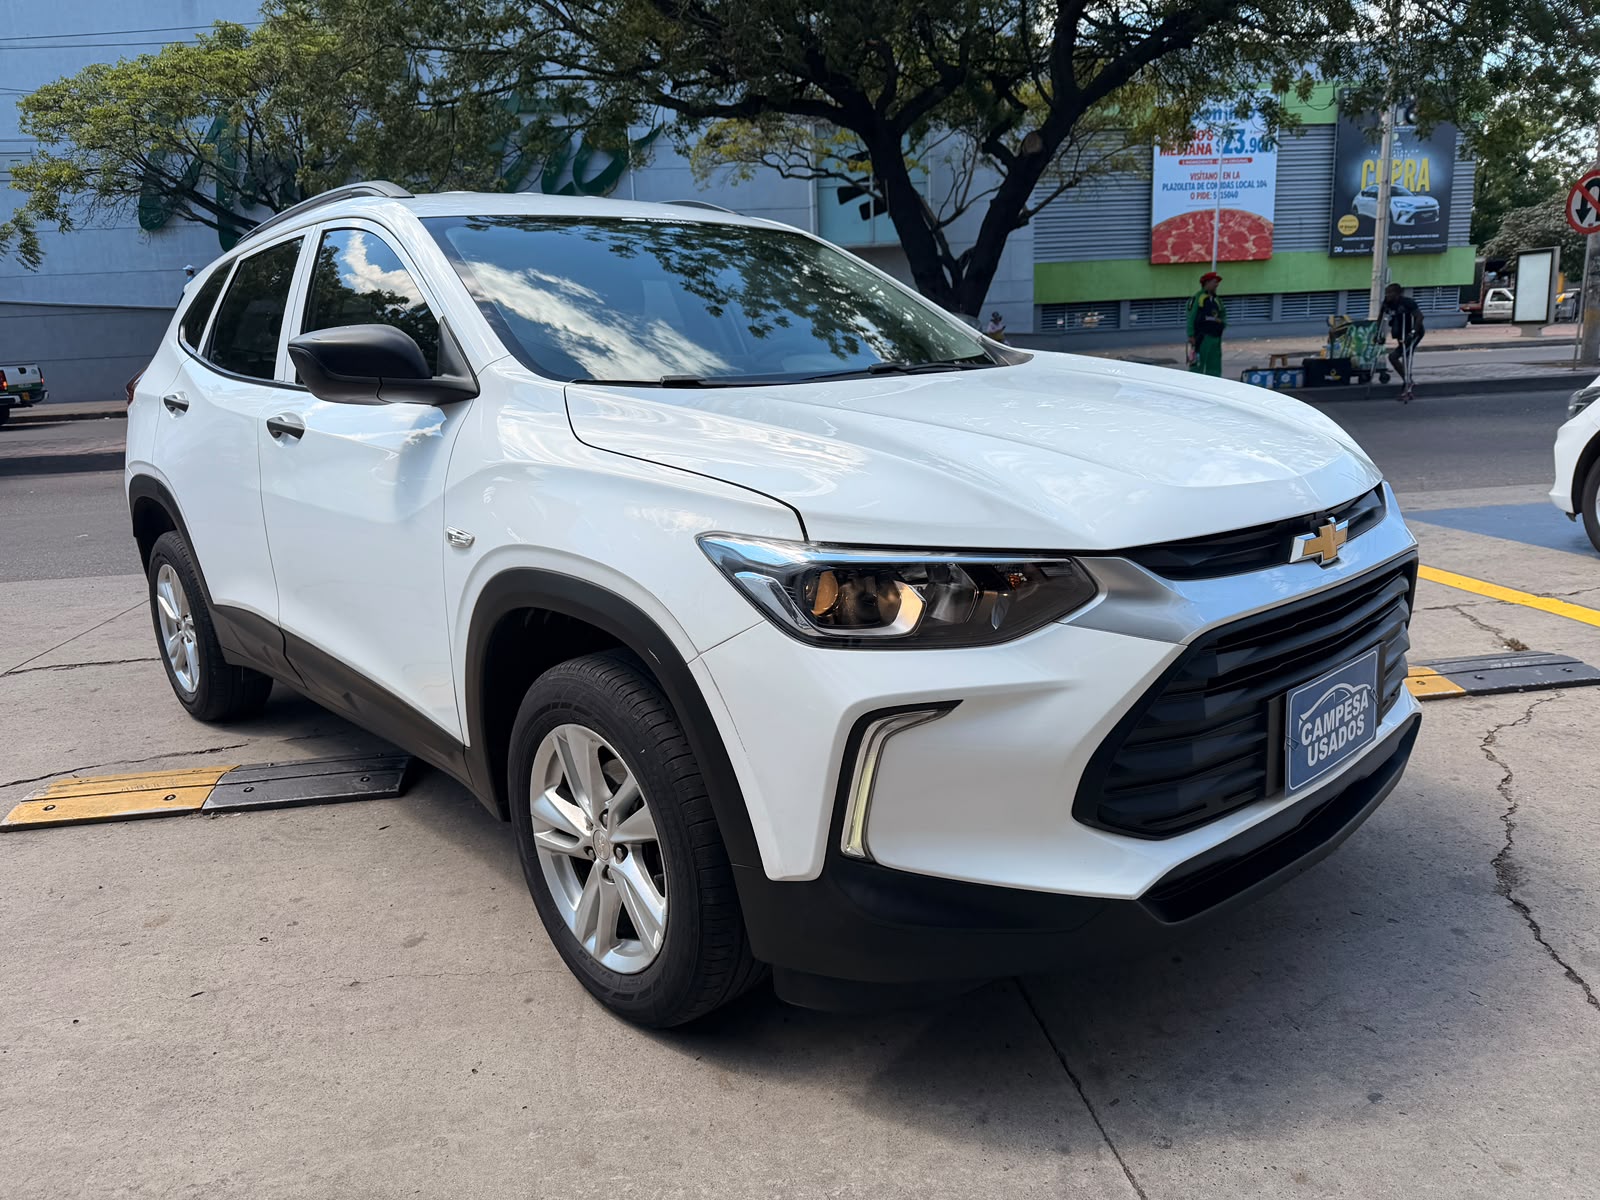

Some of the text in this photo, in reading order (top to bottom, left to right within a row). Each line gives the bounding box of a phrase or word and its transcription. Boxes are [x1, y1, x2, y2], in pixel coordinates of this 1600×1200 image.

[1160, 143, 1212, 156] MEDIANA
[1190, 171, 1240, 180] VISÍTANO EN LA
[1162, 181, 1195, 191] PLAZOLETA
[1197, 181, 1204, 190] DE
[1235, 180, 1255, 189] LOCAL
[1190, 190, 1238, 200] O PIDE: 515040
[1301, 689, 1369, 746] CAMPESA
[1307, 714, 1365, 767] USADOS
